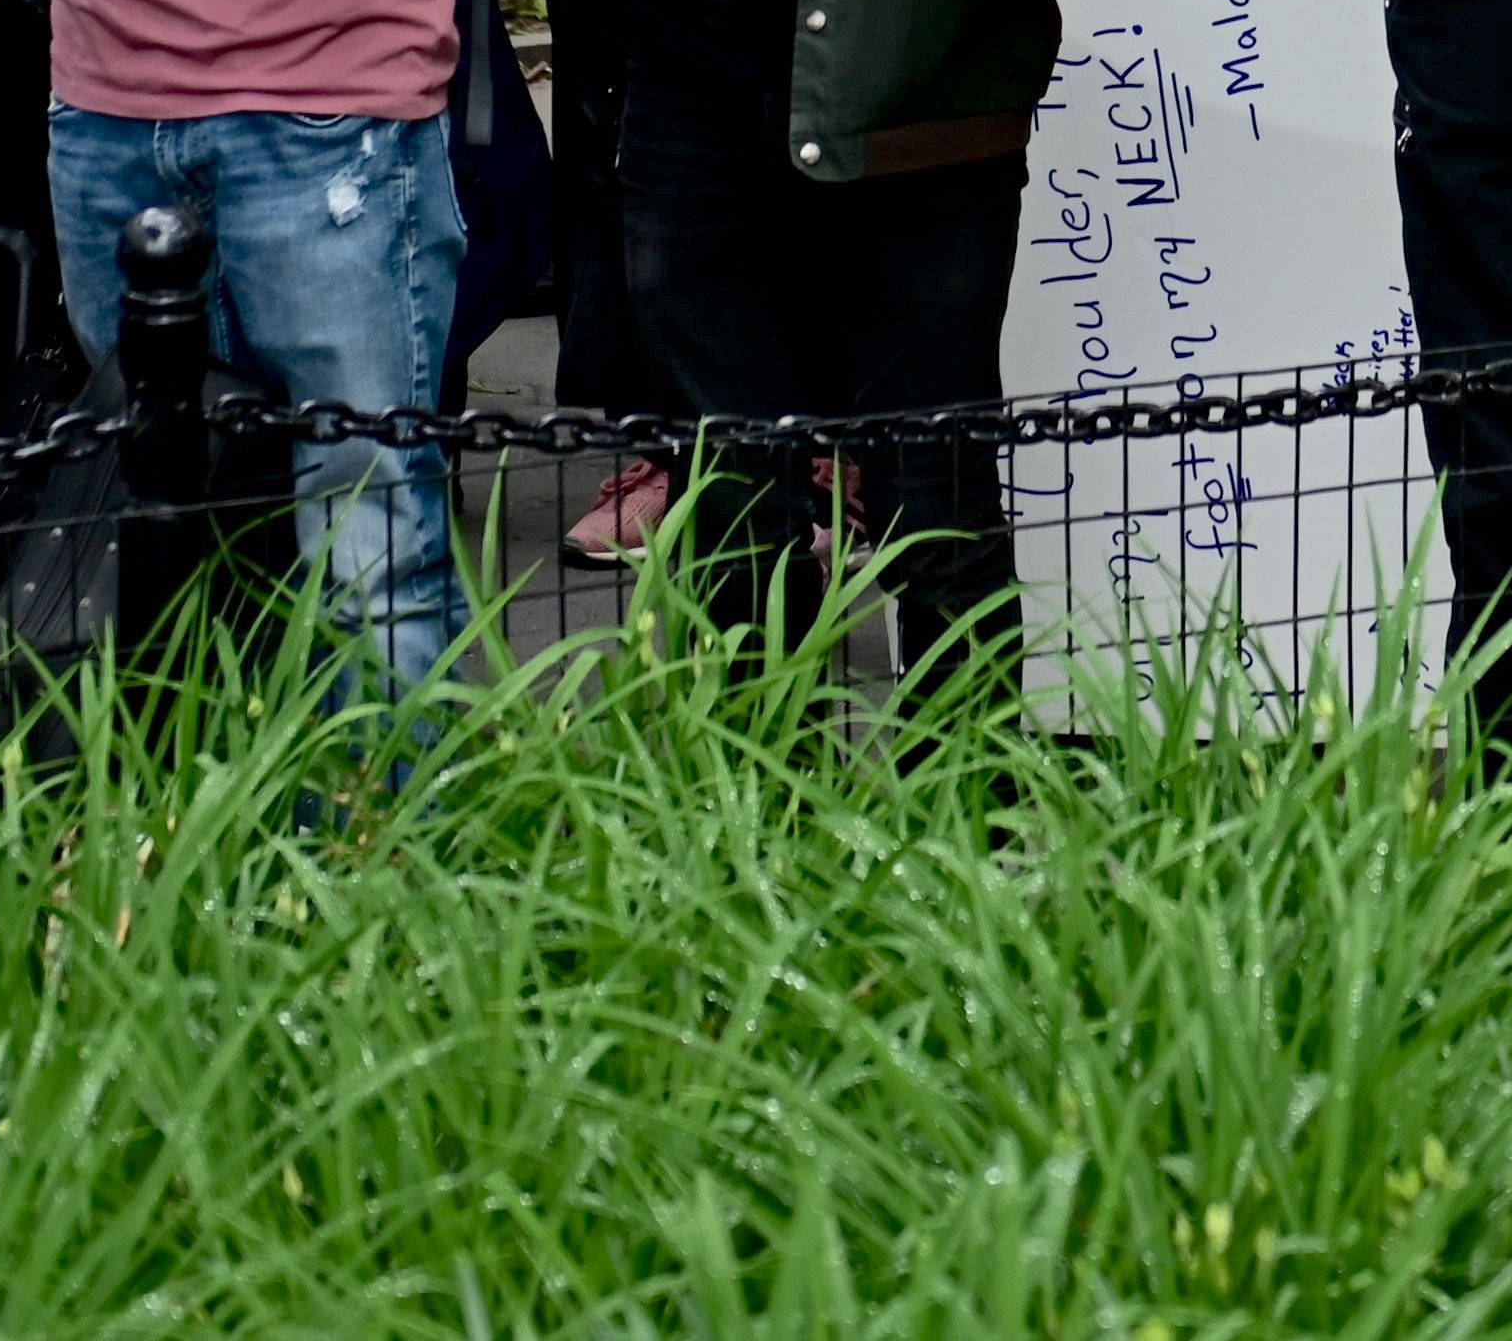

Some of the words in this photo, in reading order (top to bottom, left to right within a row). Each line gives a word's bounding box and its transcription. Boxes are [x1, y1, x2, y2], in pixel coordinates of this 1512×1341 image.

[1030, 168, 1137, 445] houlder,
[1154, 238, 1211, 309] my
[1170, 324, 1217, 401] on
